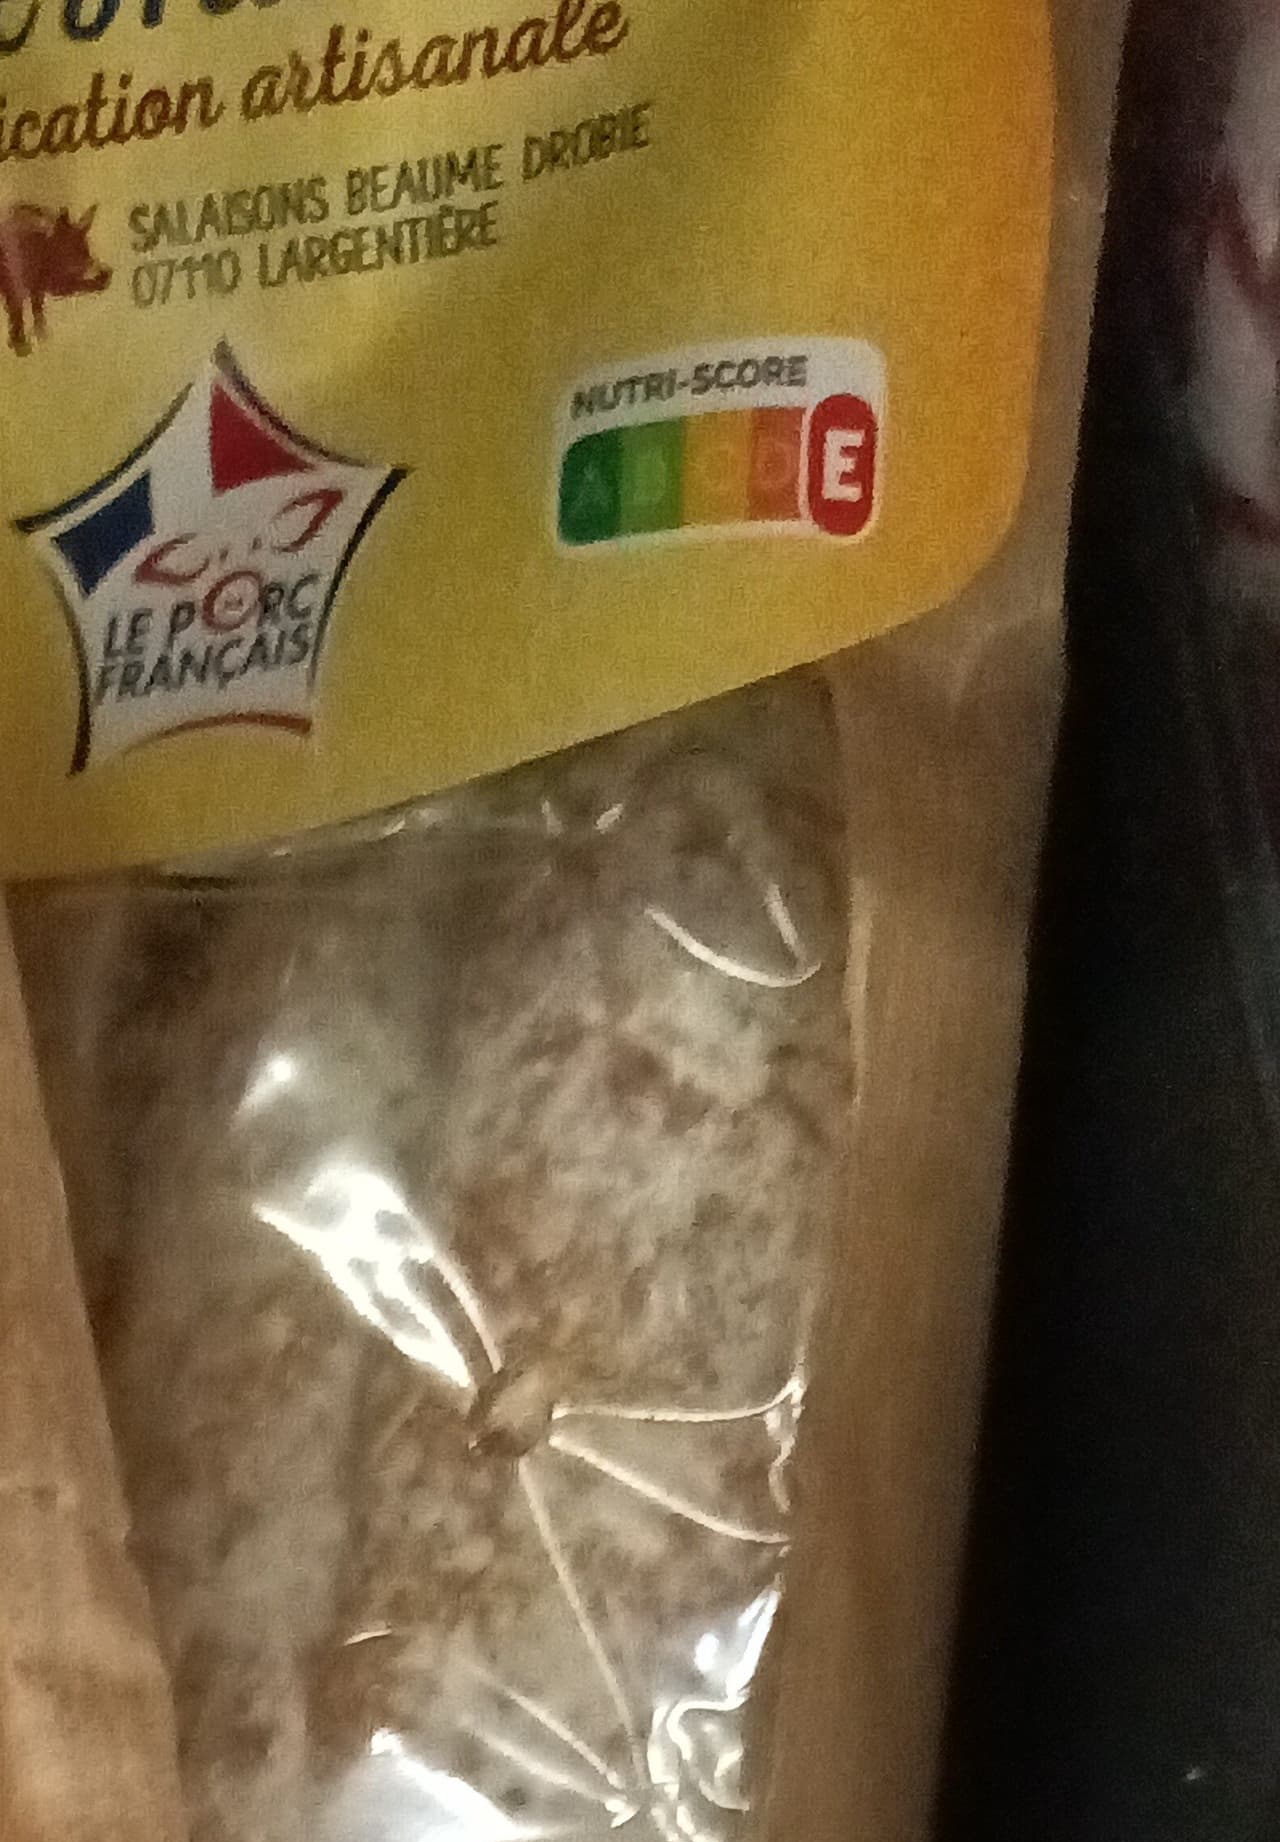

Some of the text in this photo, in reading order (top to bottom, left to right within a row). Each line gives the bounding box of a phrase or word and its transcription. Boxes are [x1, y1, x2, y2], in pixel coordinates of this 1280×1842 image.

[241, 0, 630, 121] artisanale
[128, 103, 650, 254] SALAISONS BEAUME DROBIE
[132, 249, 240, 308] 07110
[570, 355, 808, 421] NUTRI-SCORE
[822, 429, 865, 503] E
[104, 571, 322, 656] LE PORC
[92, 624, 312, 706] FRANÇAIS
